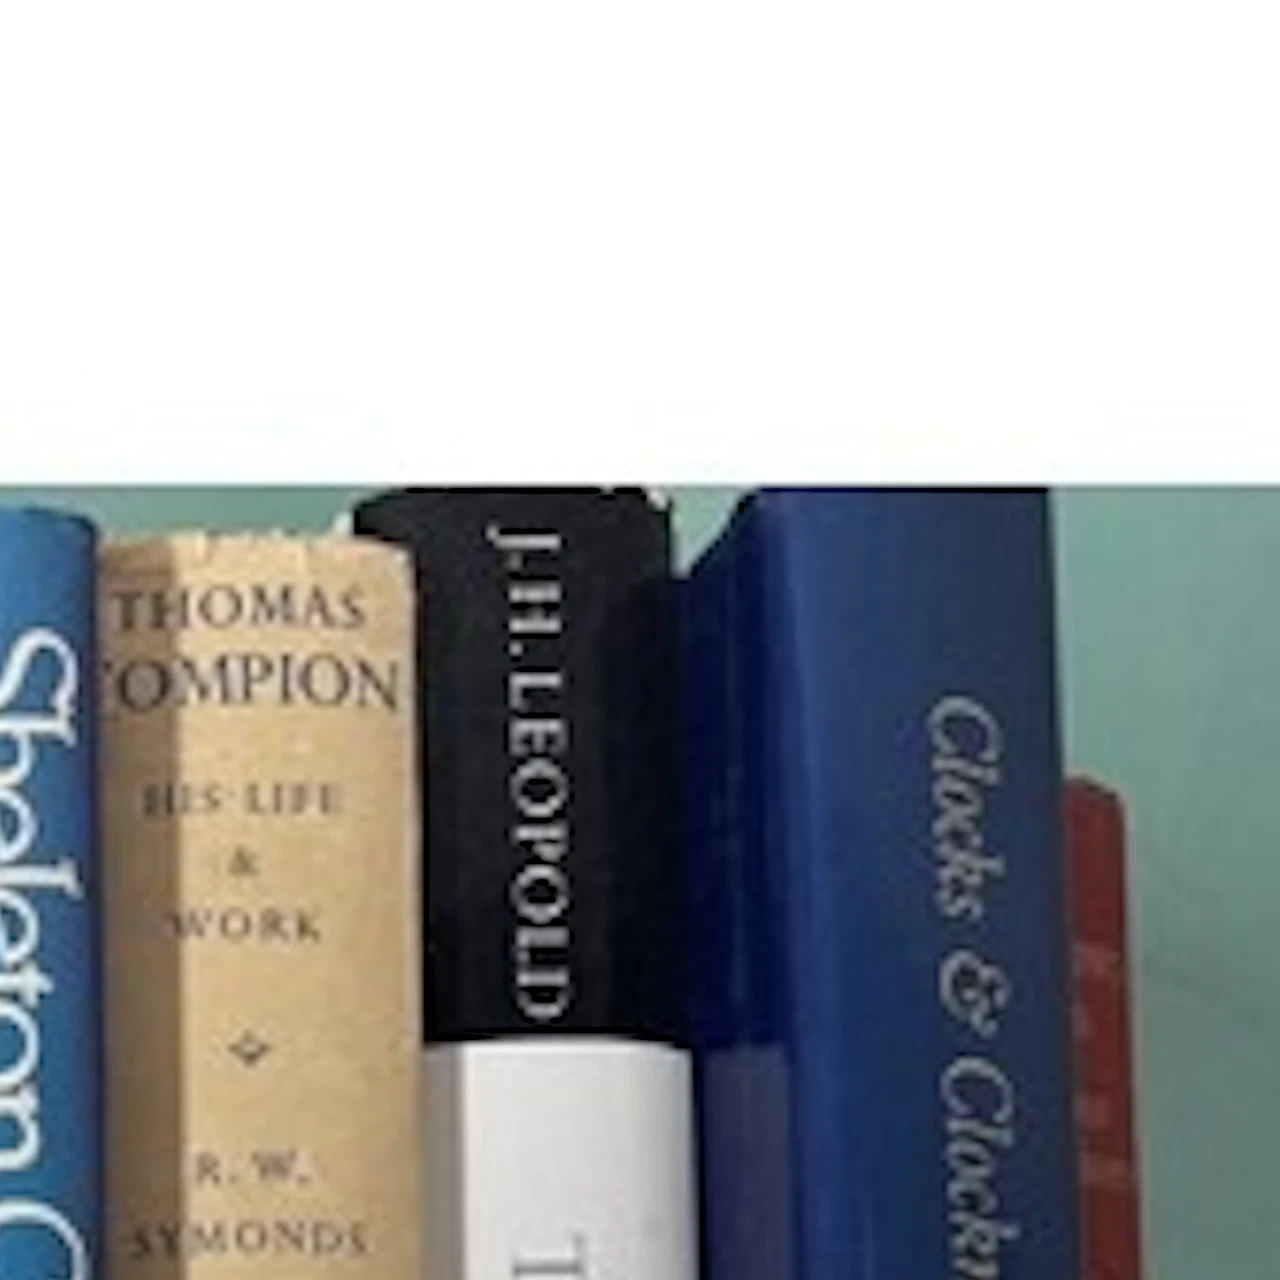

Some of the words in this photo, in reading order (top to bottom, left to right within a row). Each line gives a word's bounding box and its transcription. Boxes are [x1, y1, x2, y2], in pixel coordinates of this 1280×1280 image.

[112, 586, 368, 632] THOMAS
[144, 783, 224, 820] HIS
[249, 783, 342, 816] LIFE
[926, 695, 1008, 921] Clocks
[230, 846, 261, 879] &
[169, 908, 325, 945] WORK
[939, 947, 1009, 1037] &
[193, 1150, 238, 1185] R.
[253, 1148, 311, 1184] W.
[127, 1220, 370, 1260] SYMONDS
